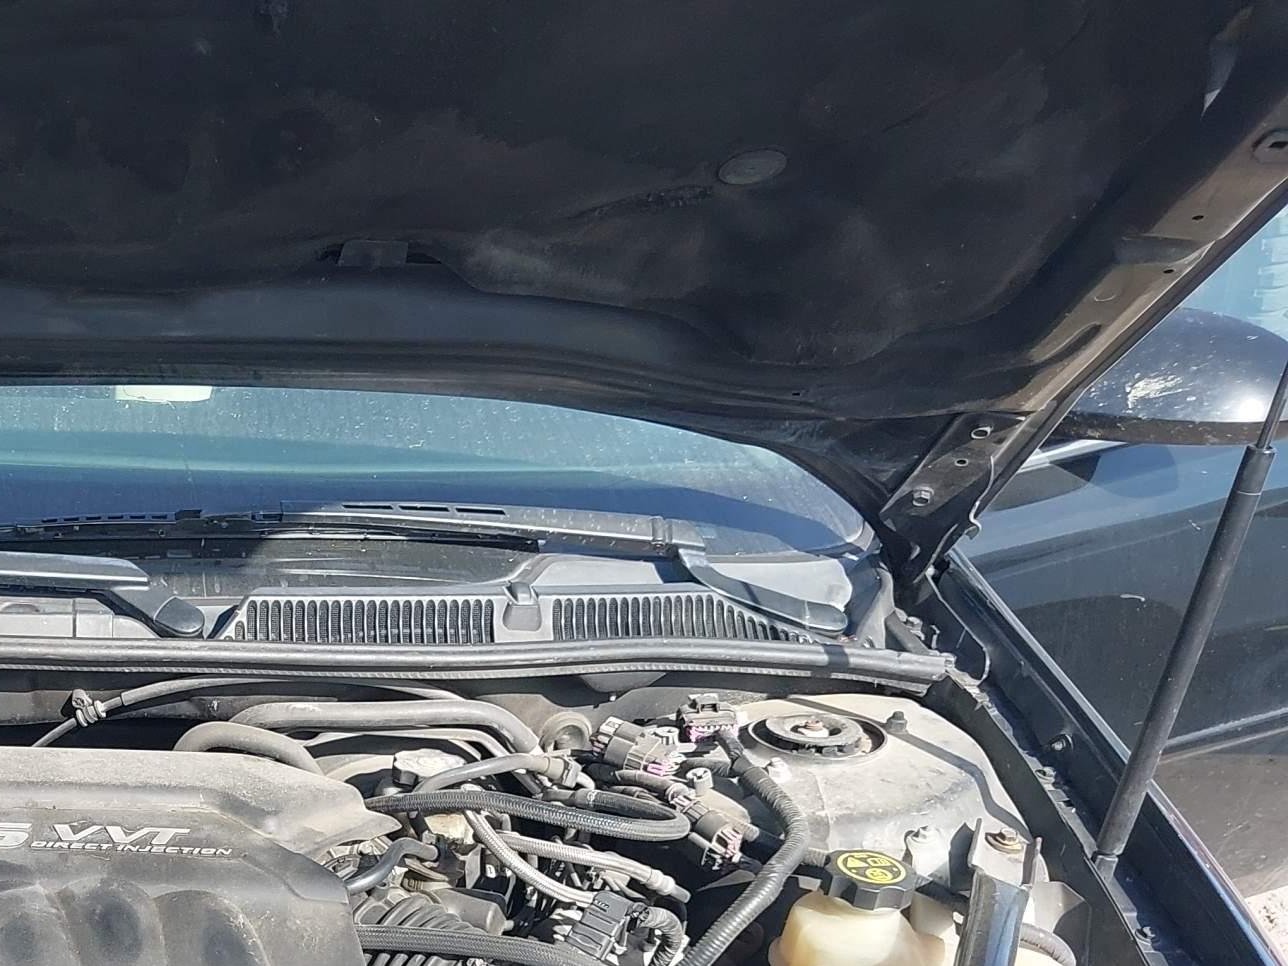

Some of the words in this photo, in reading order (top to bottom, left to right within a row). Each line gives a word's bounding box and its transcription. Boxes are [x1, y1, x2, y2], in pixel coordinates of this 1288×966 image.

[52, 822, 191, 846] VVT
[30, 840, 113, 851] DIRECT
[115, 845, 233, 857] INJECTION
